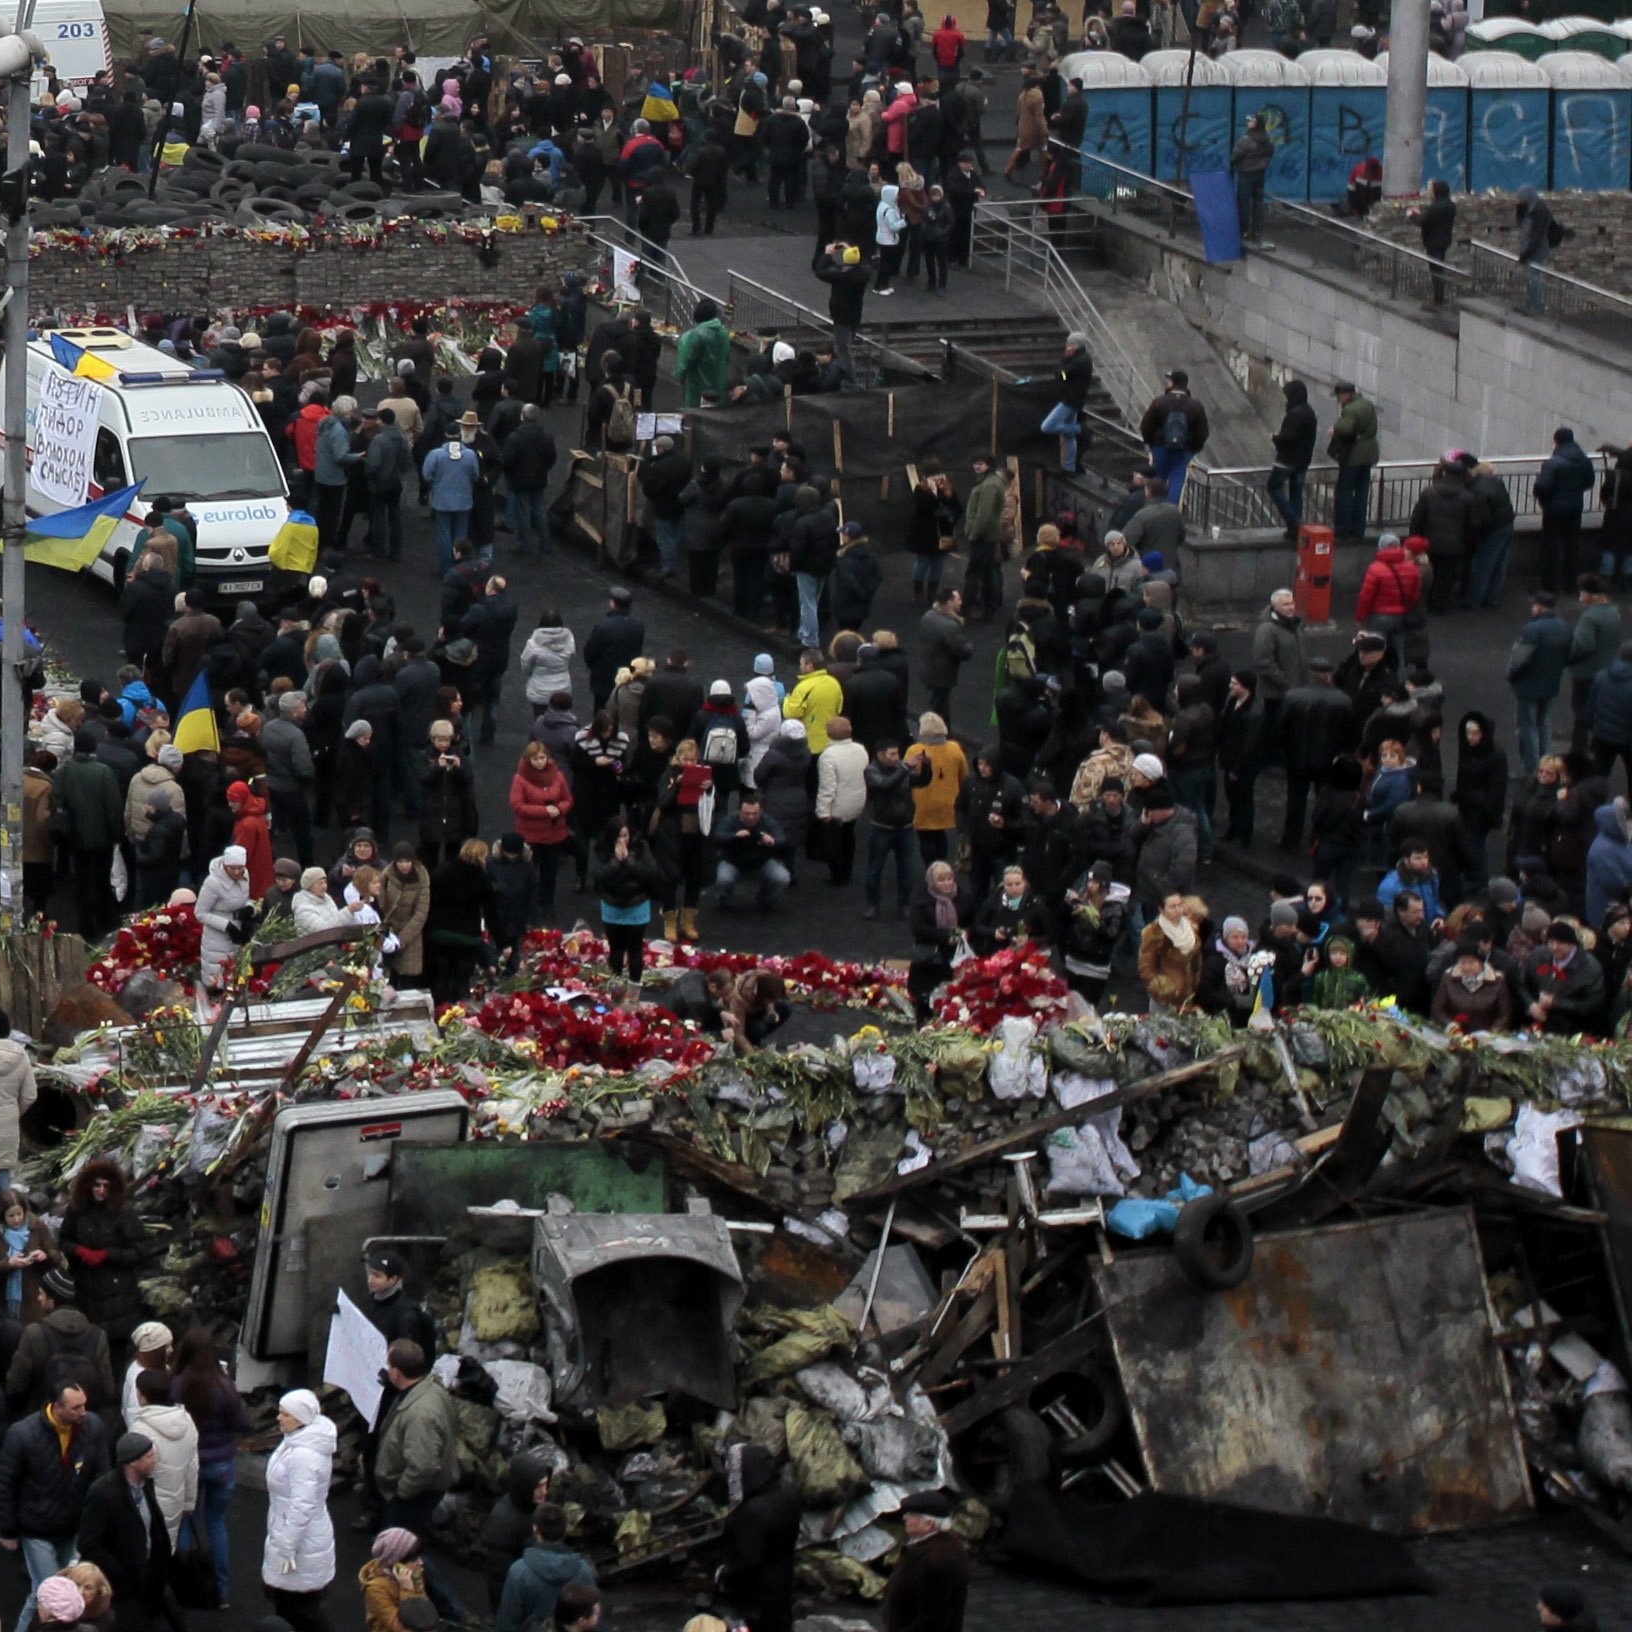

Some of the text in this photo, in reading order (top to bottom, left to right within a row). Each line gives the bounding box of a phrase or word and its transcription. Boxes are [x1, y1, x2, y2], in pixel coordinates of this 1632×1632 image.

[57, 22, 95, 39] 203
[46, 369, 100, 414] ПУТИН
[203, 505, 278, 523] eurolab
